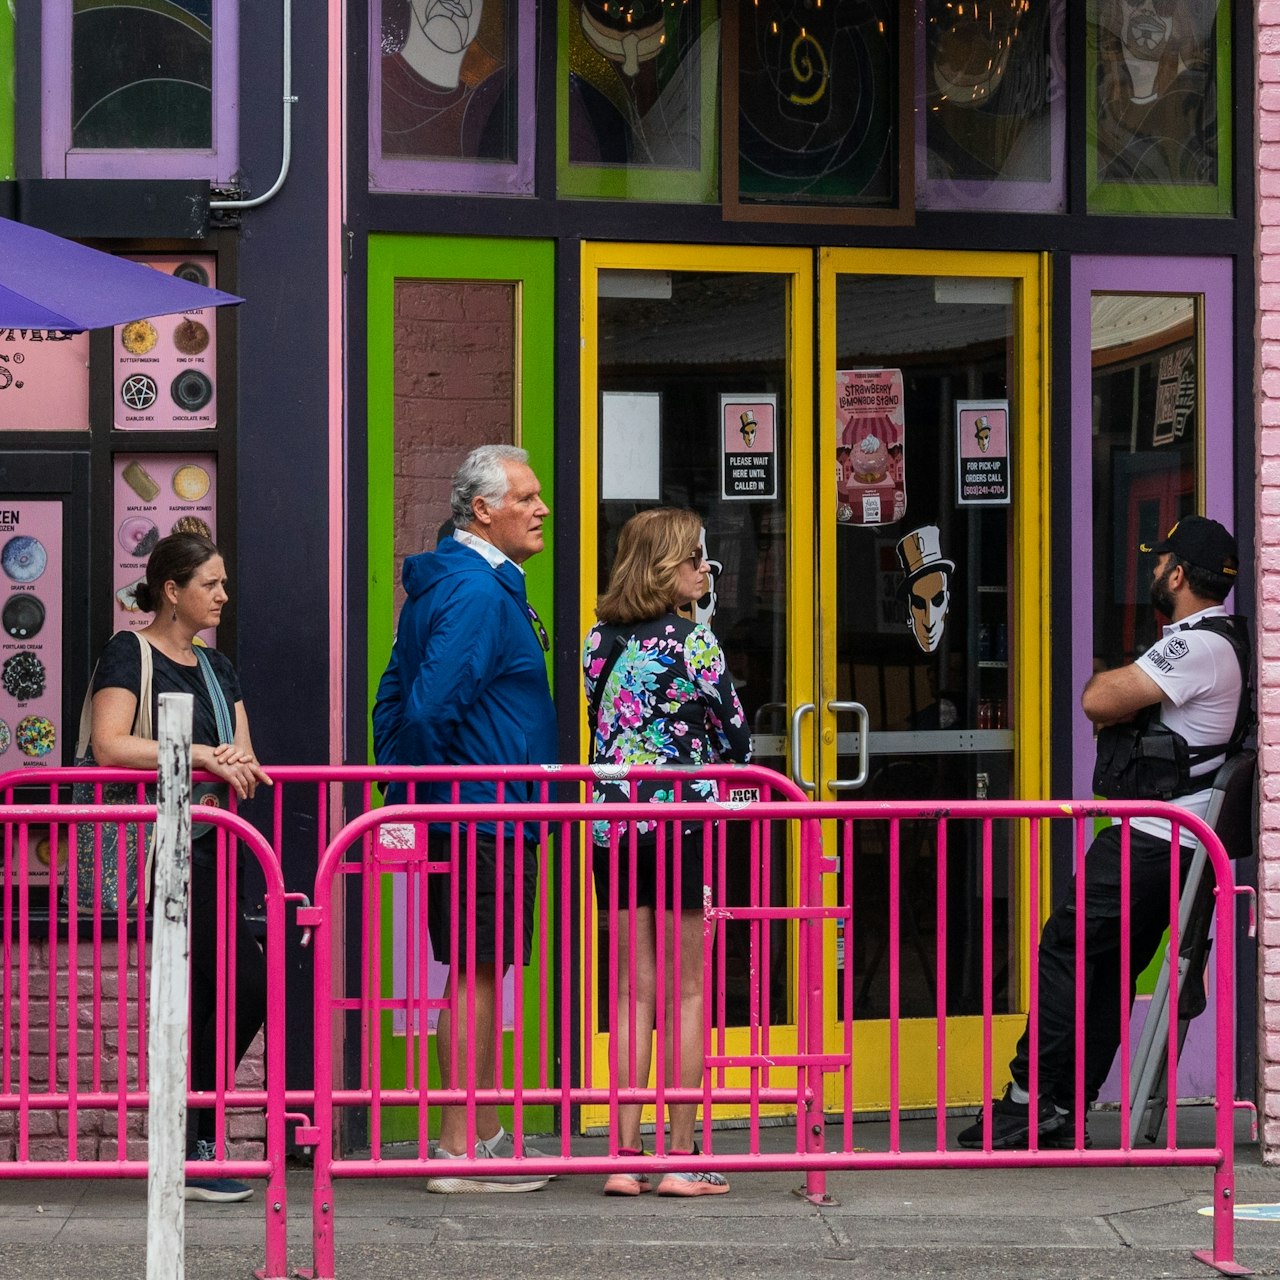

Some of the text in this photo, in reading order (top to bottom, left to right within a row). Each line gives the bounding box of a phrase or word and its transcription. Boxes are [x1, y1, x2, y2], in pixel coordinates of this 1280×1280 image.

[730, 457, 768, 466] PLEASE WAIT
[967, 461, 1001, 470] FOR PICK-UP
[733, 469, 766, 478] HERE UNTIL
[966, 474, 1002, 482] ORDERS CALL
[734, 481, 765, 490] CALLED IN
